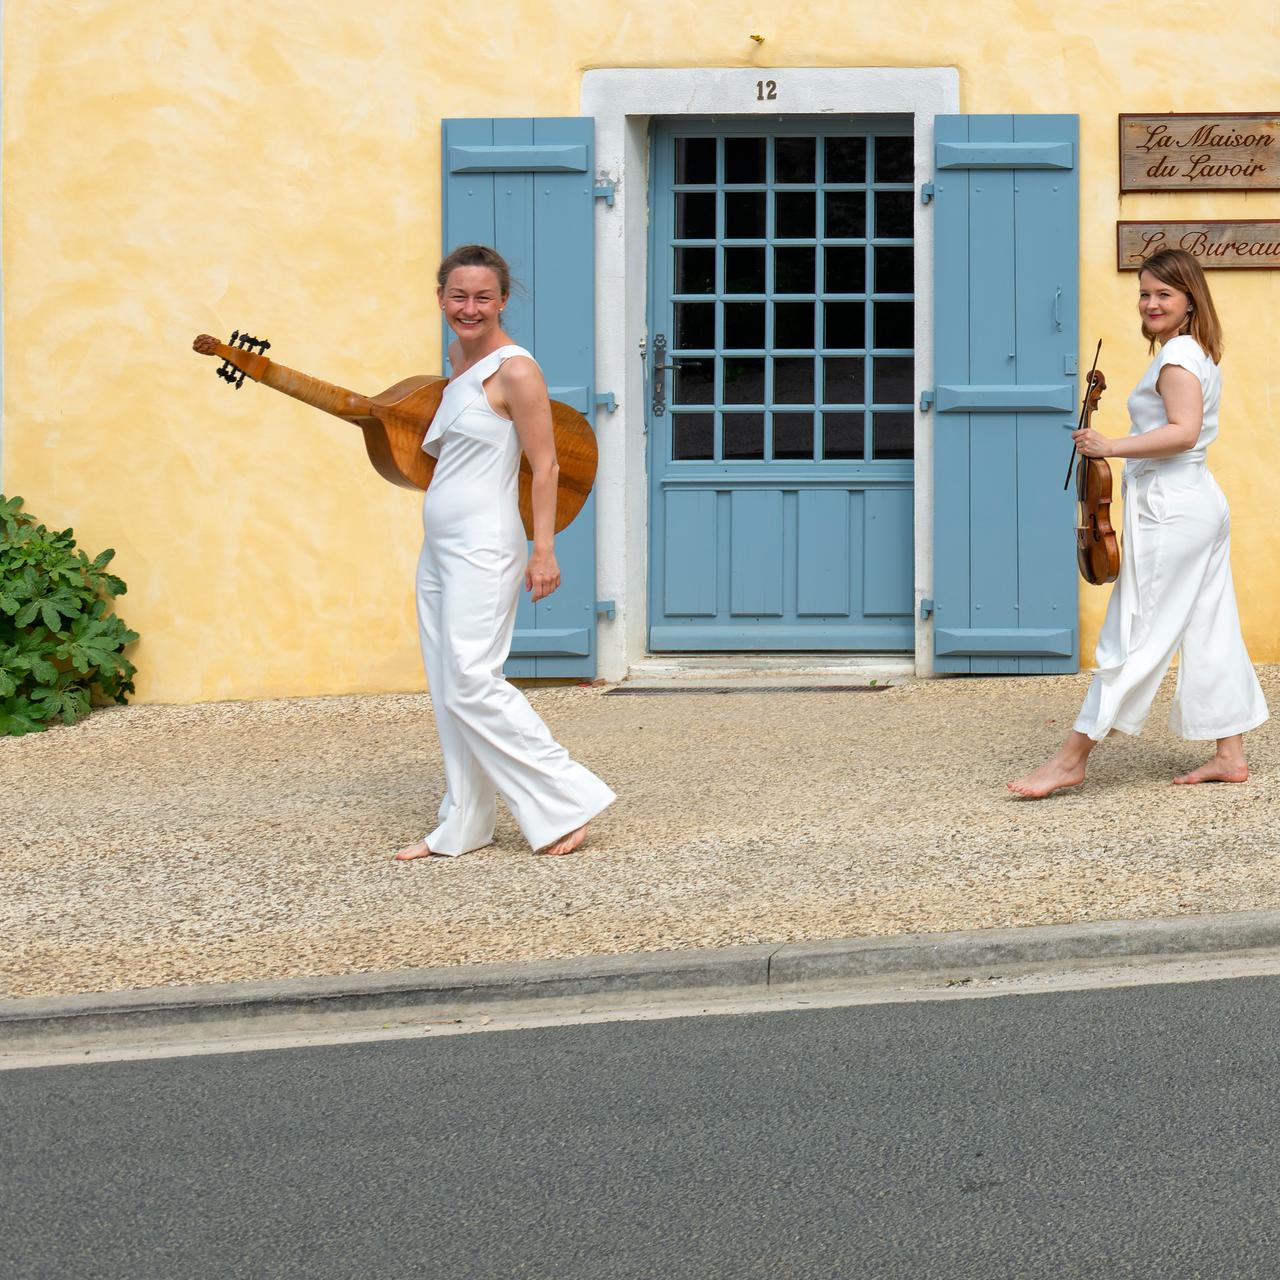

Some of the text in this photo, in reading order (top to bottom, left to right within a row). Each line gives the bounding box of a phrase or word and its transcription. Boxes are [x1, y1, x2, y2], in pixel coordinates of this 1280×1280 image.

[756, 80, 777, 100] 12
[1136, 124, 1275, 153] La Maison
[1146, 154, 1266, 181] du Lavoir
